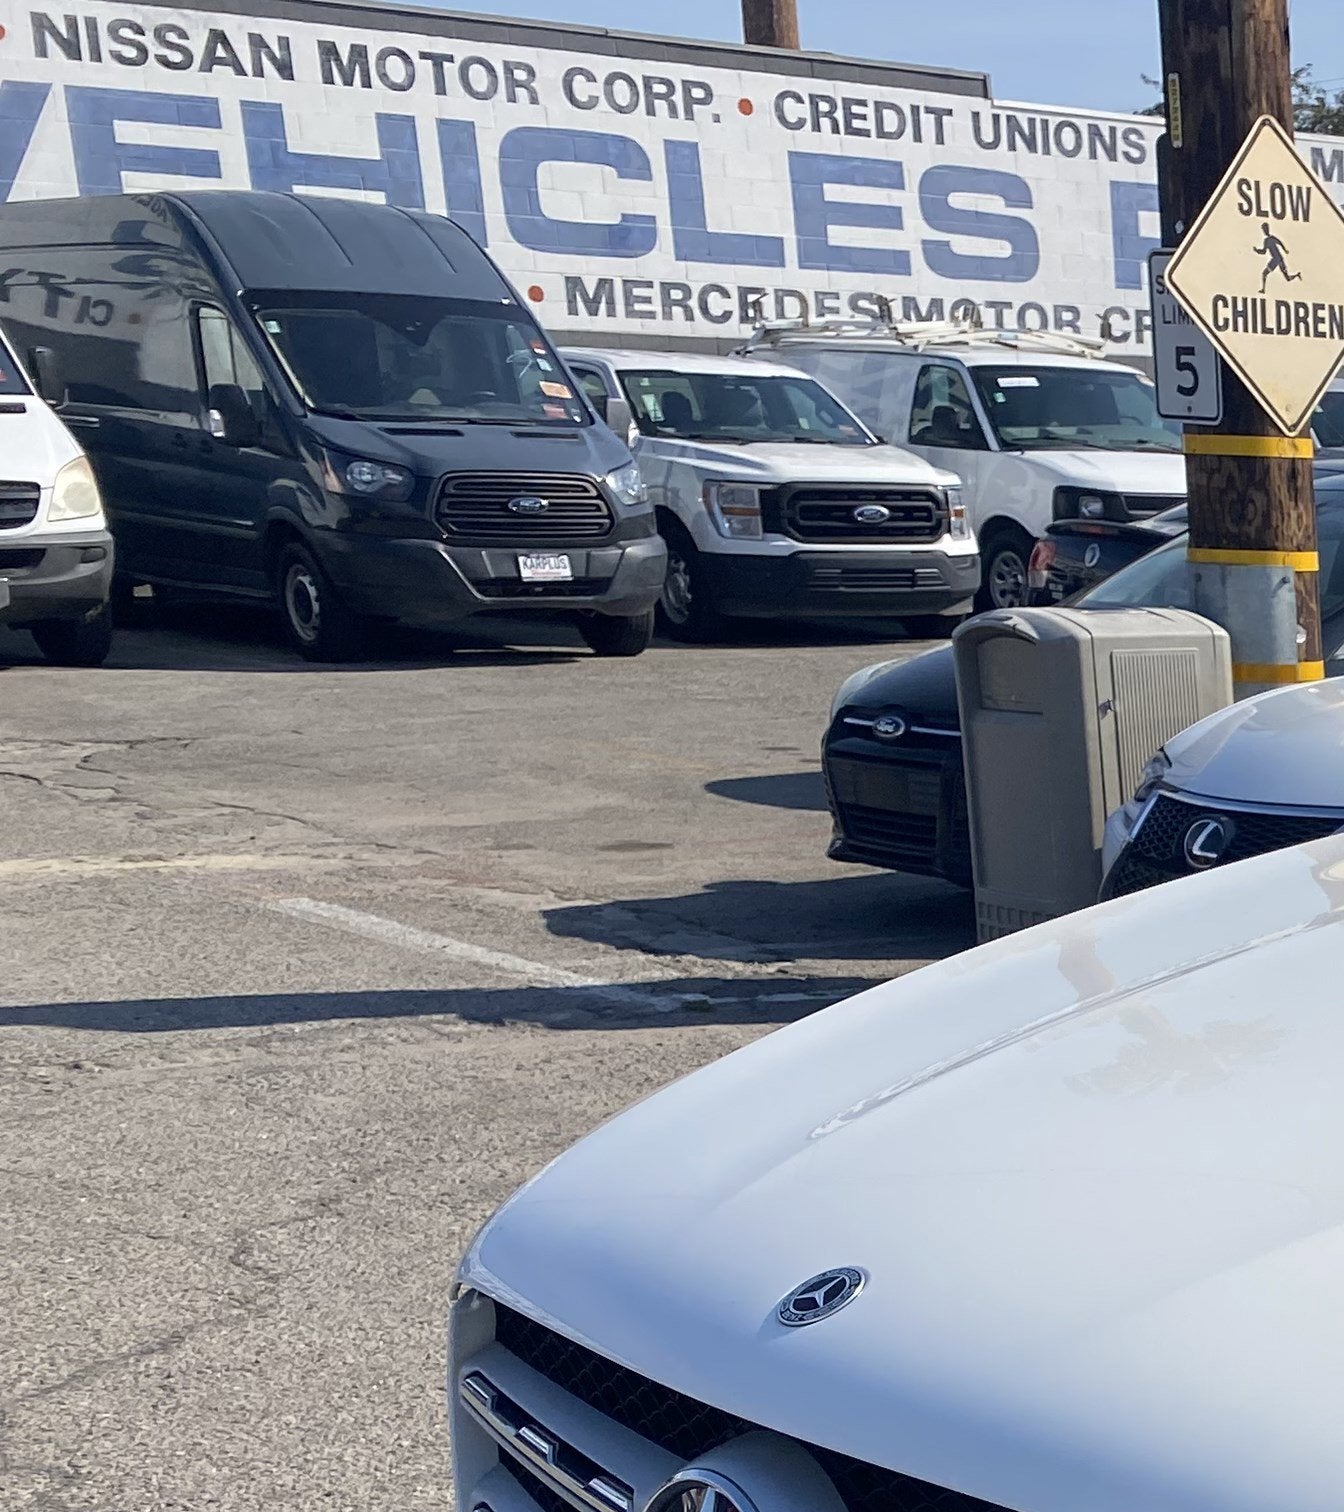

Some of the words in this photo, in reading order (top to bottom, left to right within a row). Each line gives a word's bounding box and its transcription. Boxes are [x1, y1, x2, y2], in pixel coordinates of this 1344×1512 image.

[30, 11, 294, 82] NISSAN
[317, 39, 539, 105] MOTOR
[561, 65, 722, 123] CORP.
[774, 89, 953, 144] CREDIT
[972, 111, 1147, 166] UNIONS
[1237, 178, 1312, 222] SLOW
[1162, 304, 1195, 325] LIM
[1211, 294, 1344, 341] CHILDREN
[1175, 346, 1198, 396] 5
[522, 557, 567, 570] KARPLUS
